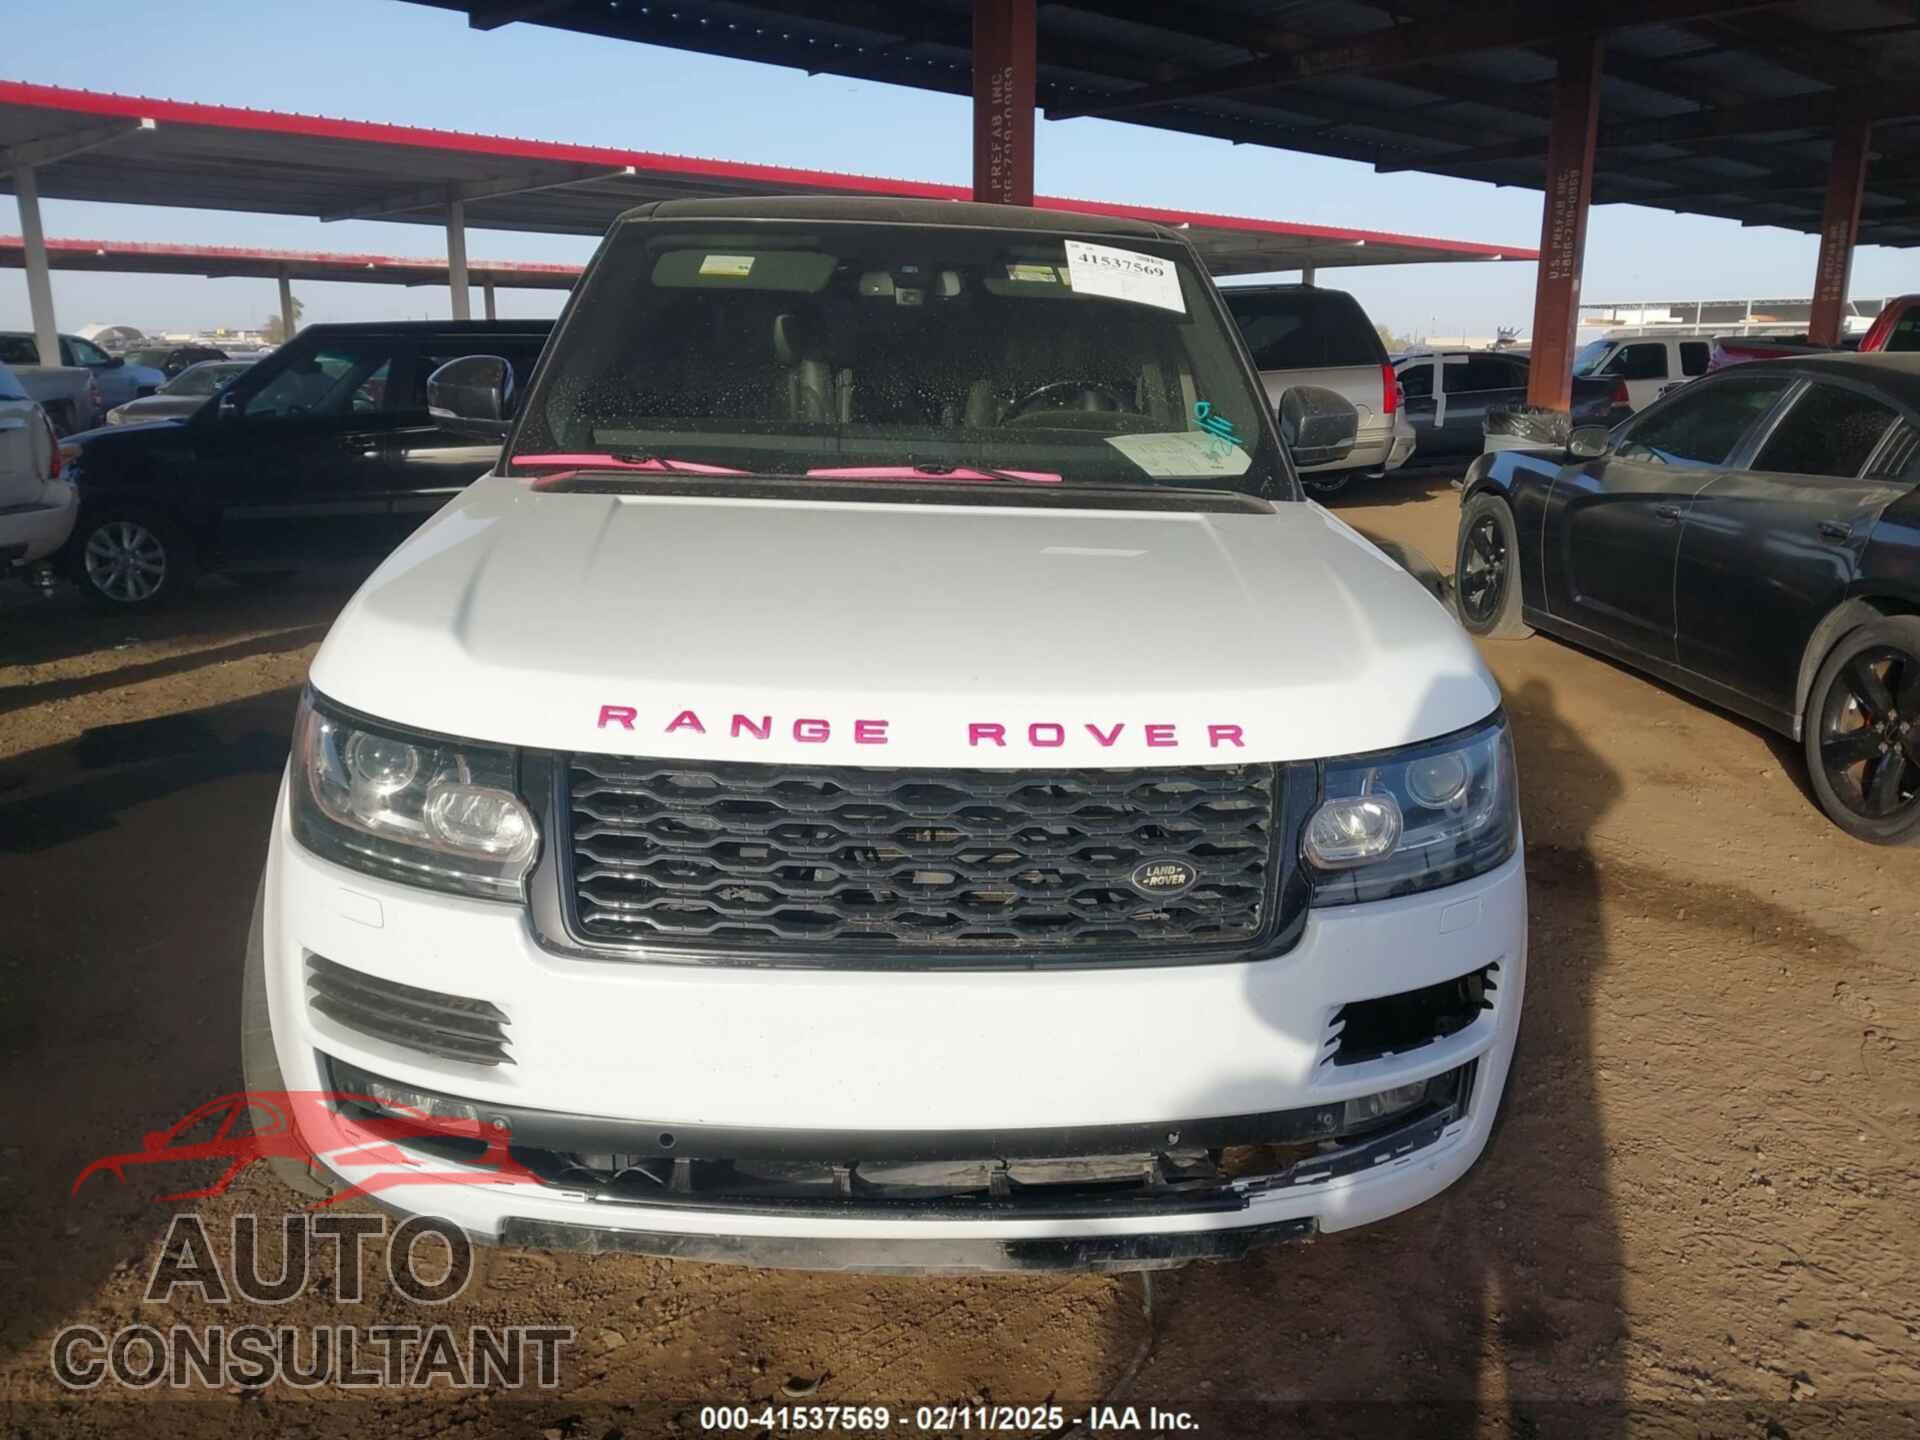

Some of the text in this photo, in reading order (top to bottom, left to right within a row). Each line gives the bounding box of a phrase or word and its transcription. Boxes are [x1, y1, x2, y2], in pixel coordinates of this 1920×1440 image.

[991, 114, 1002, 190] PREFAB
[1078, 253, 1164, 277] 41537569
[597, 705, 1246, 748] RANGE ROVER
